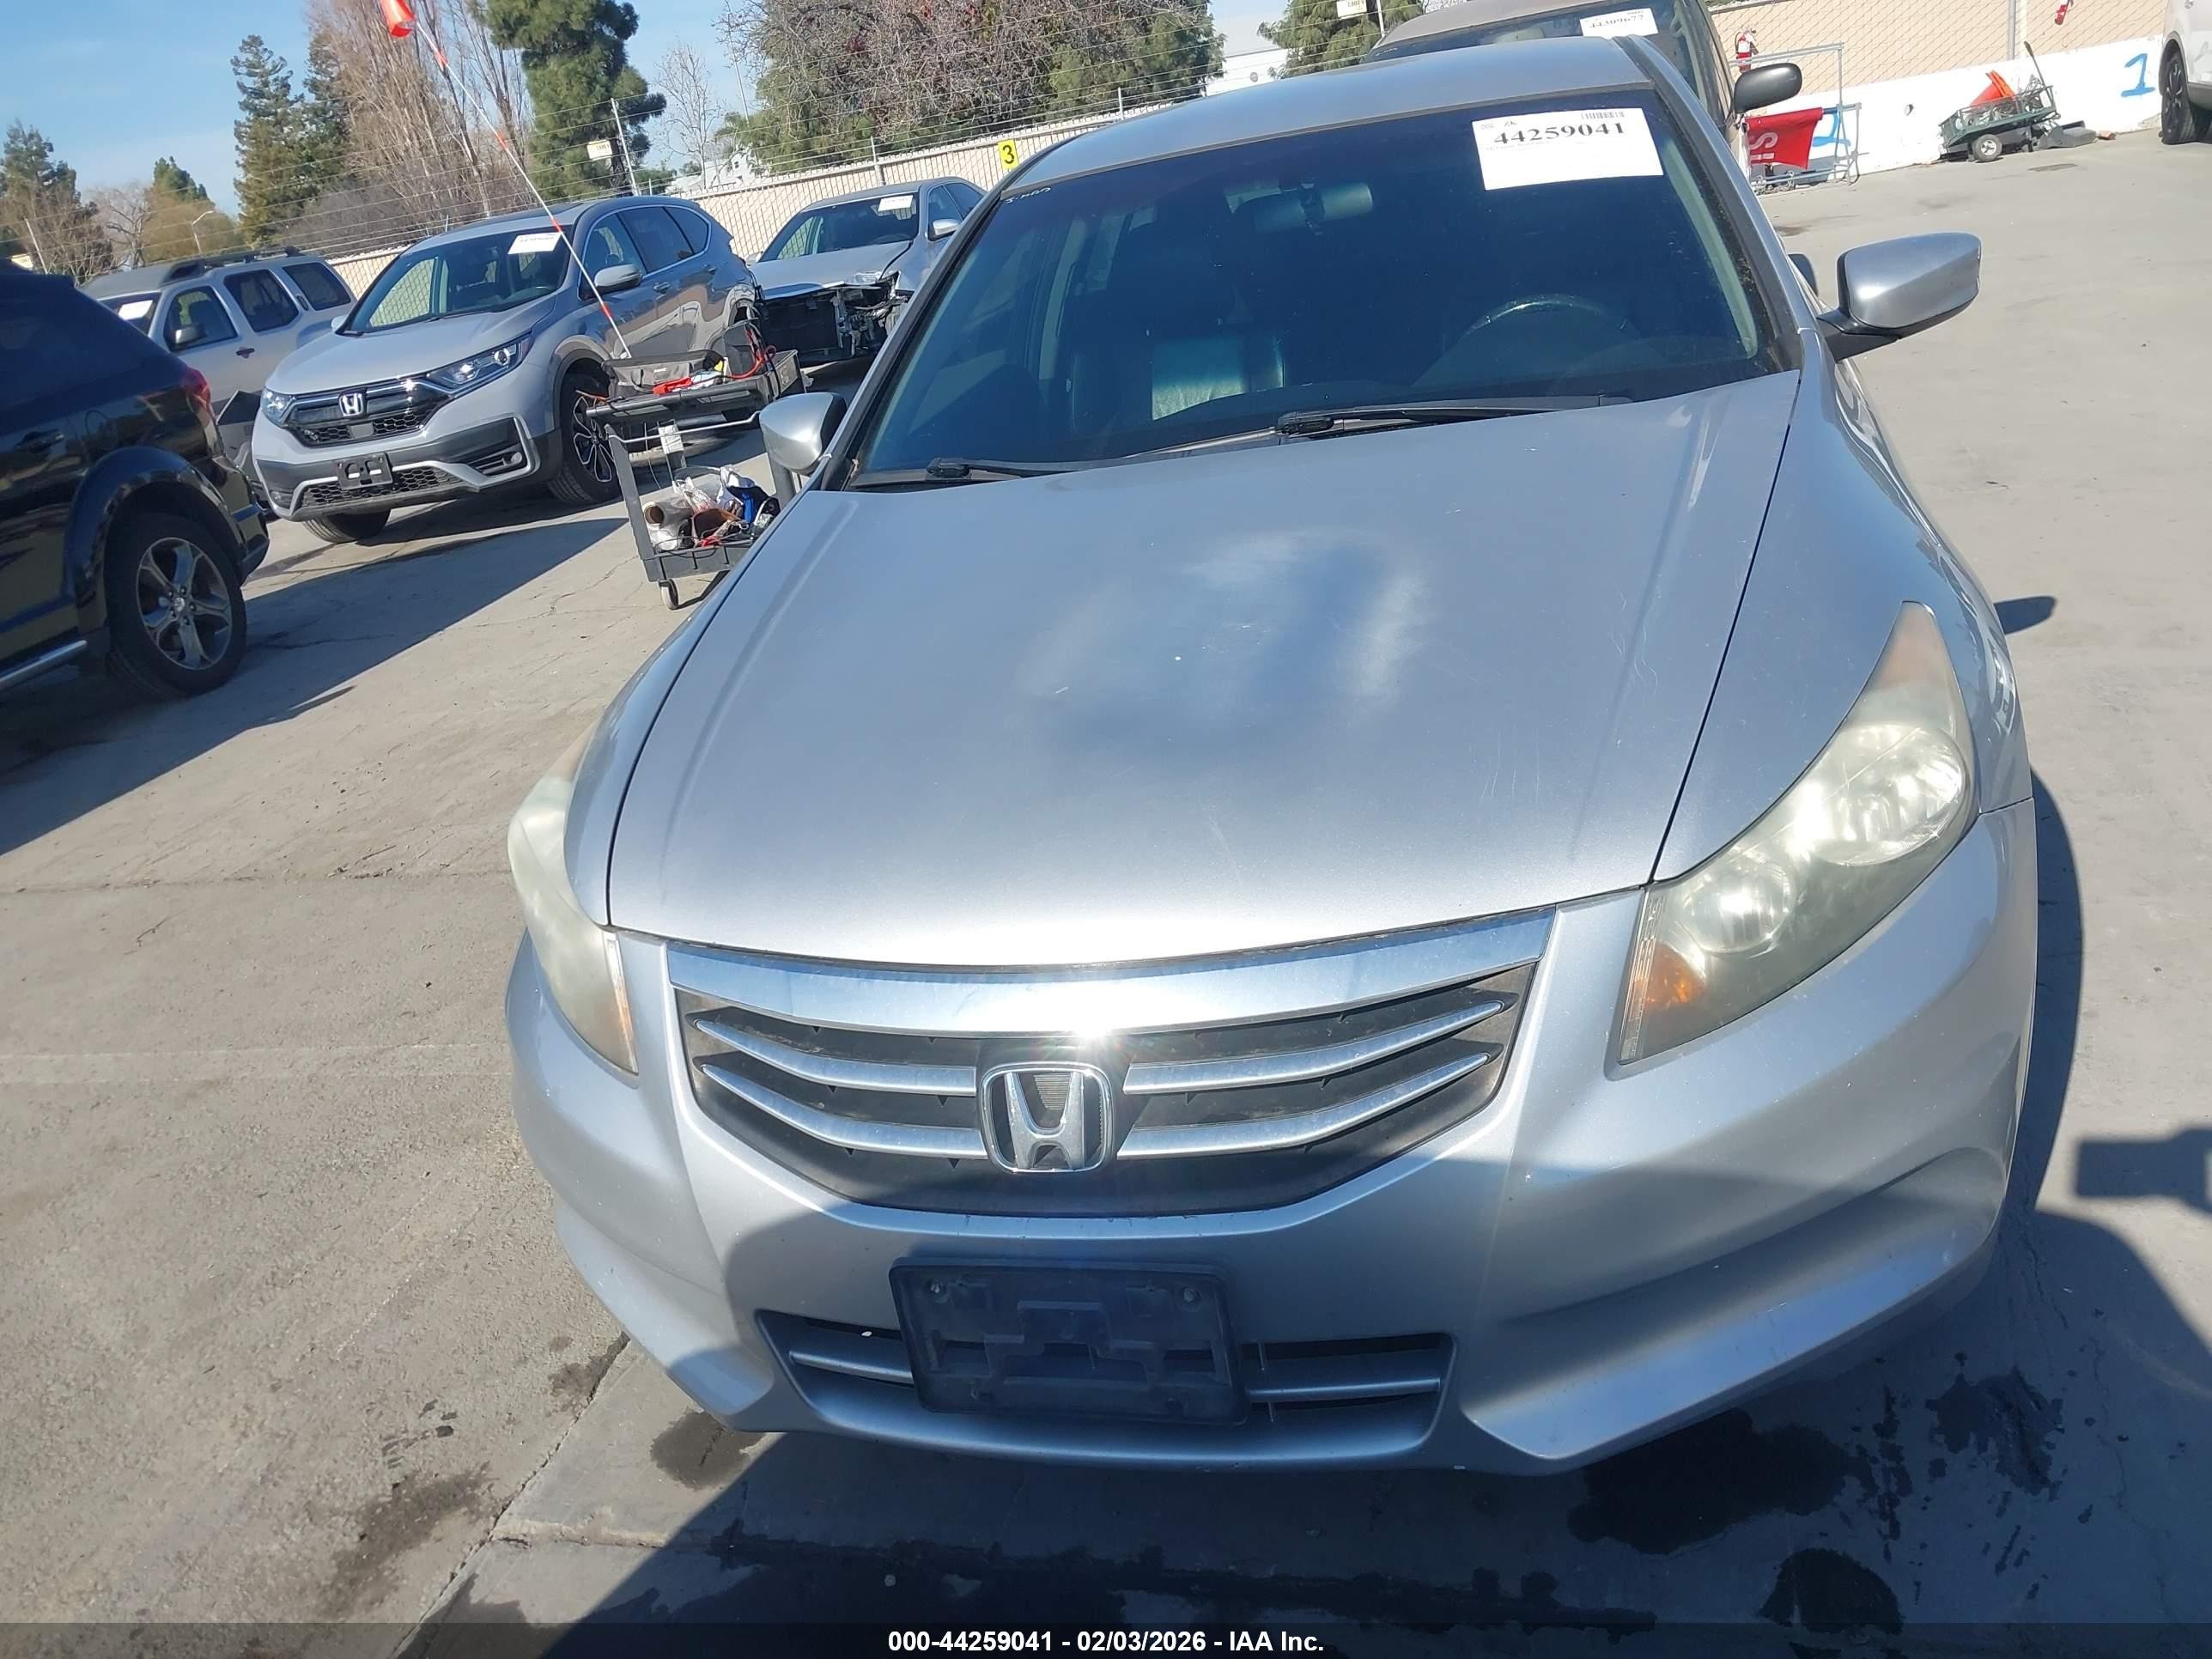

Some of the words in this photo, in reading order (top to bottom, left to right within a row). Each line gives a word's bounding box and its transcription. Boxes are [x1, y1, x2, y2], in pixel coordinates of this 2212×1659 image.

[2121, 53, 2155, 97] 1
[1494, 122, 1626, 144] 44259041
[1002, 144, 1015, 164] 3
